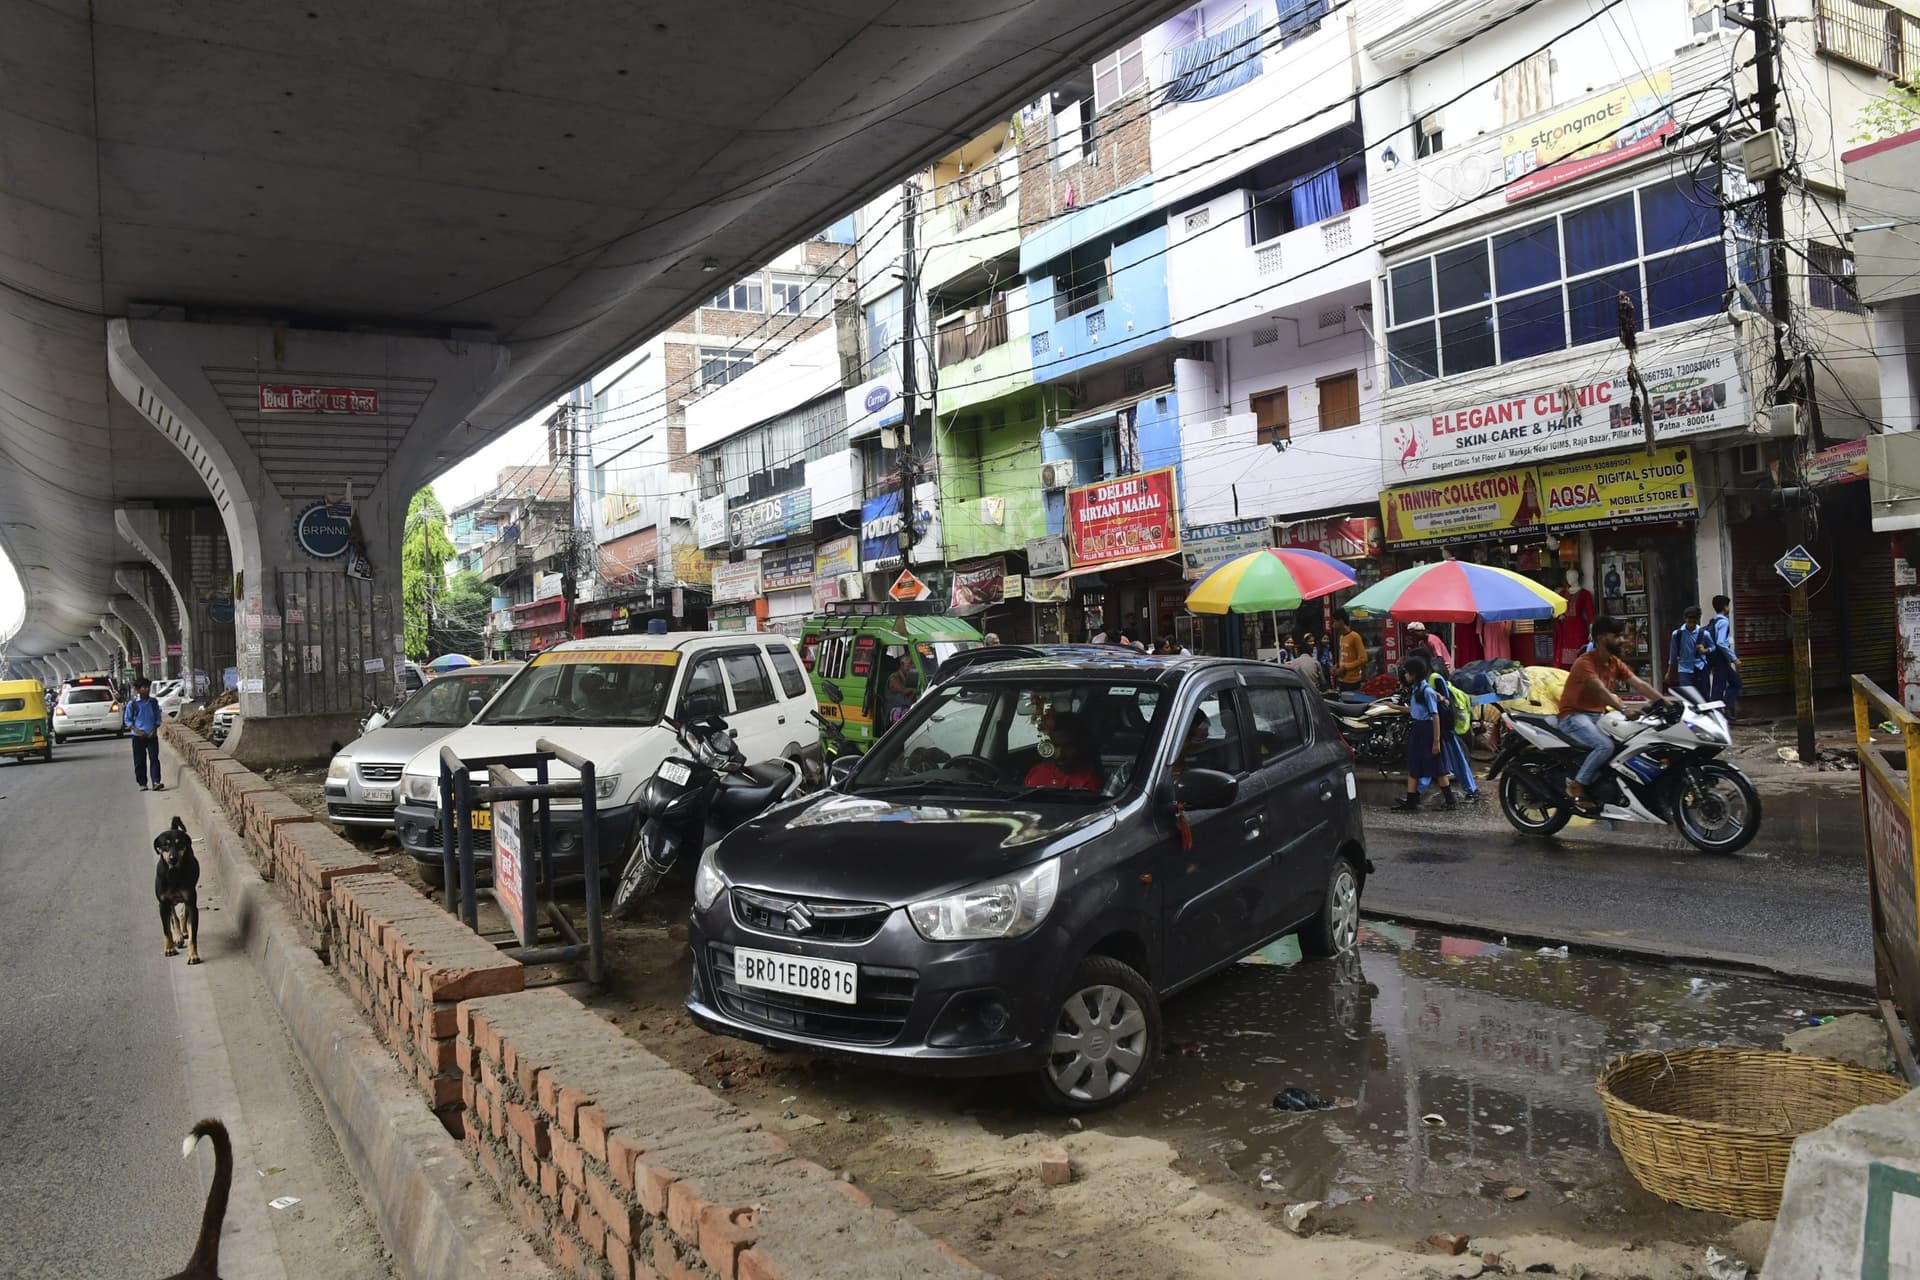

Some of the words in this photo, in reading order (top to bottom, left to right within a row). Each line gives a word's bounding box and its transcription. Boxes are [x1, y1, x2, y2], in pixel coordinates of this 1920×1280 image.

[867, 391, 887, 407] Carrier
[1432, 399, 1526, 436] ELEGANT
[1432, 458, 1453, 471] Elegant
[1454, 457, 1470, 467] Clinic
[1471, 455, 1481, 464] 1st
[1482, 453, 1497, 463] Floor
[1573, 436, 1588, 447] Raja
[1612, 429, 1630, 440] Pillar
[1686, 414, 1715, 427] 800014
[1456, 433, 1487, 449] SKIN
[1491, 425, 1527, 442] CARE
[1533, 422, 1542, 435] &
[1548, 415, 1583, 433] HAIR
[1597, 470, 1640, 486] DIGITAL
[1641, 463, 1685, 479] STUDIO
[1098, 480, 1138, 502] DELHI
[1548, 482, 1602, 511] AQSA
[1610, 493, 1644, 507] MOBILE
[1647, 490, 1679, 502] STORE
[1079, 501, 1120, 523] BIRYANI
[1122, 493, 1161, 514] MAHAL
[303, 526, 349, 536] BRPNNL
[1181, 518, 1268, 541] SAMSUNG
[1281, 522, 1328, 545] A-ONE
[551, 651, 665, 664] AMBULANCE
[820, 704, 838, 717] CNG
[745, 957, 853, 994] BR01ED8816
